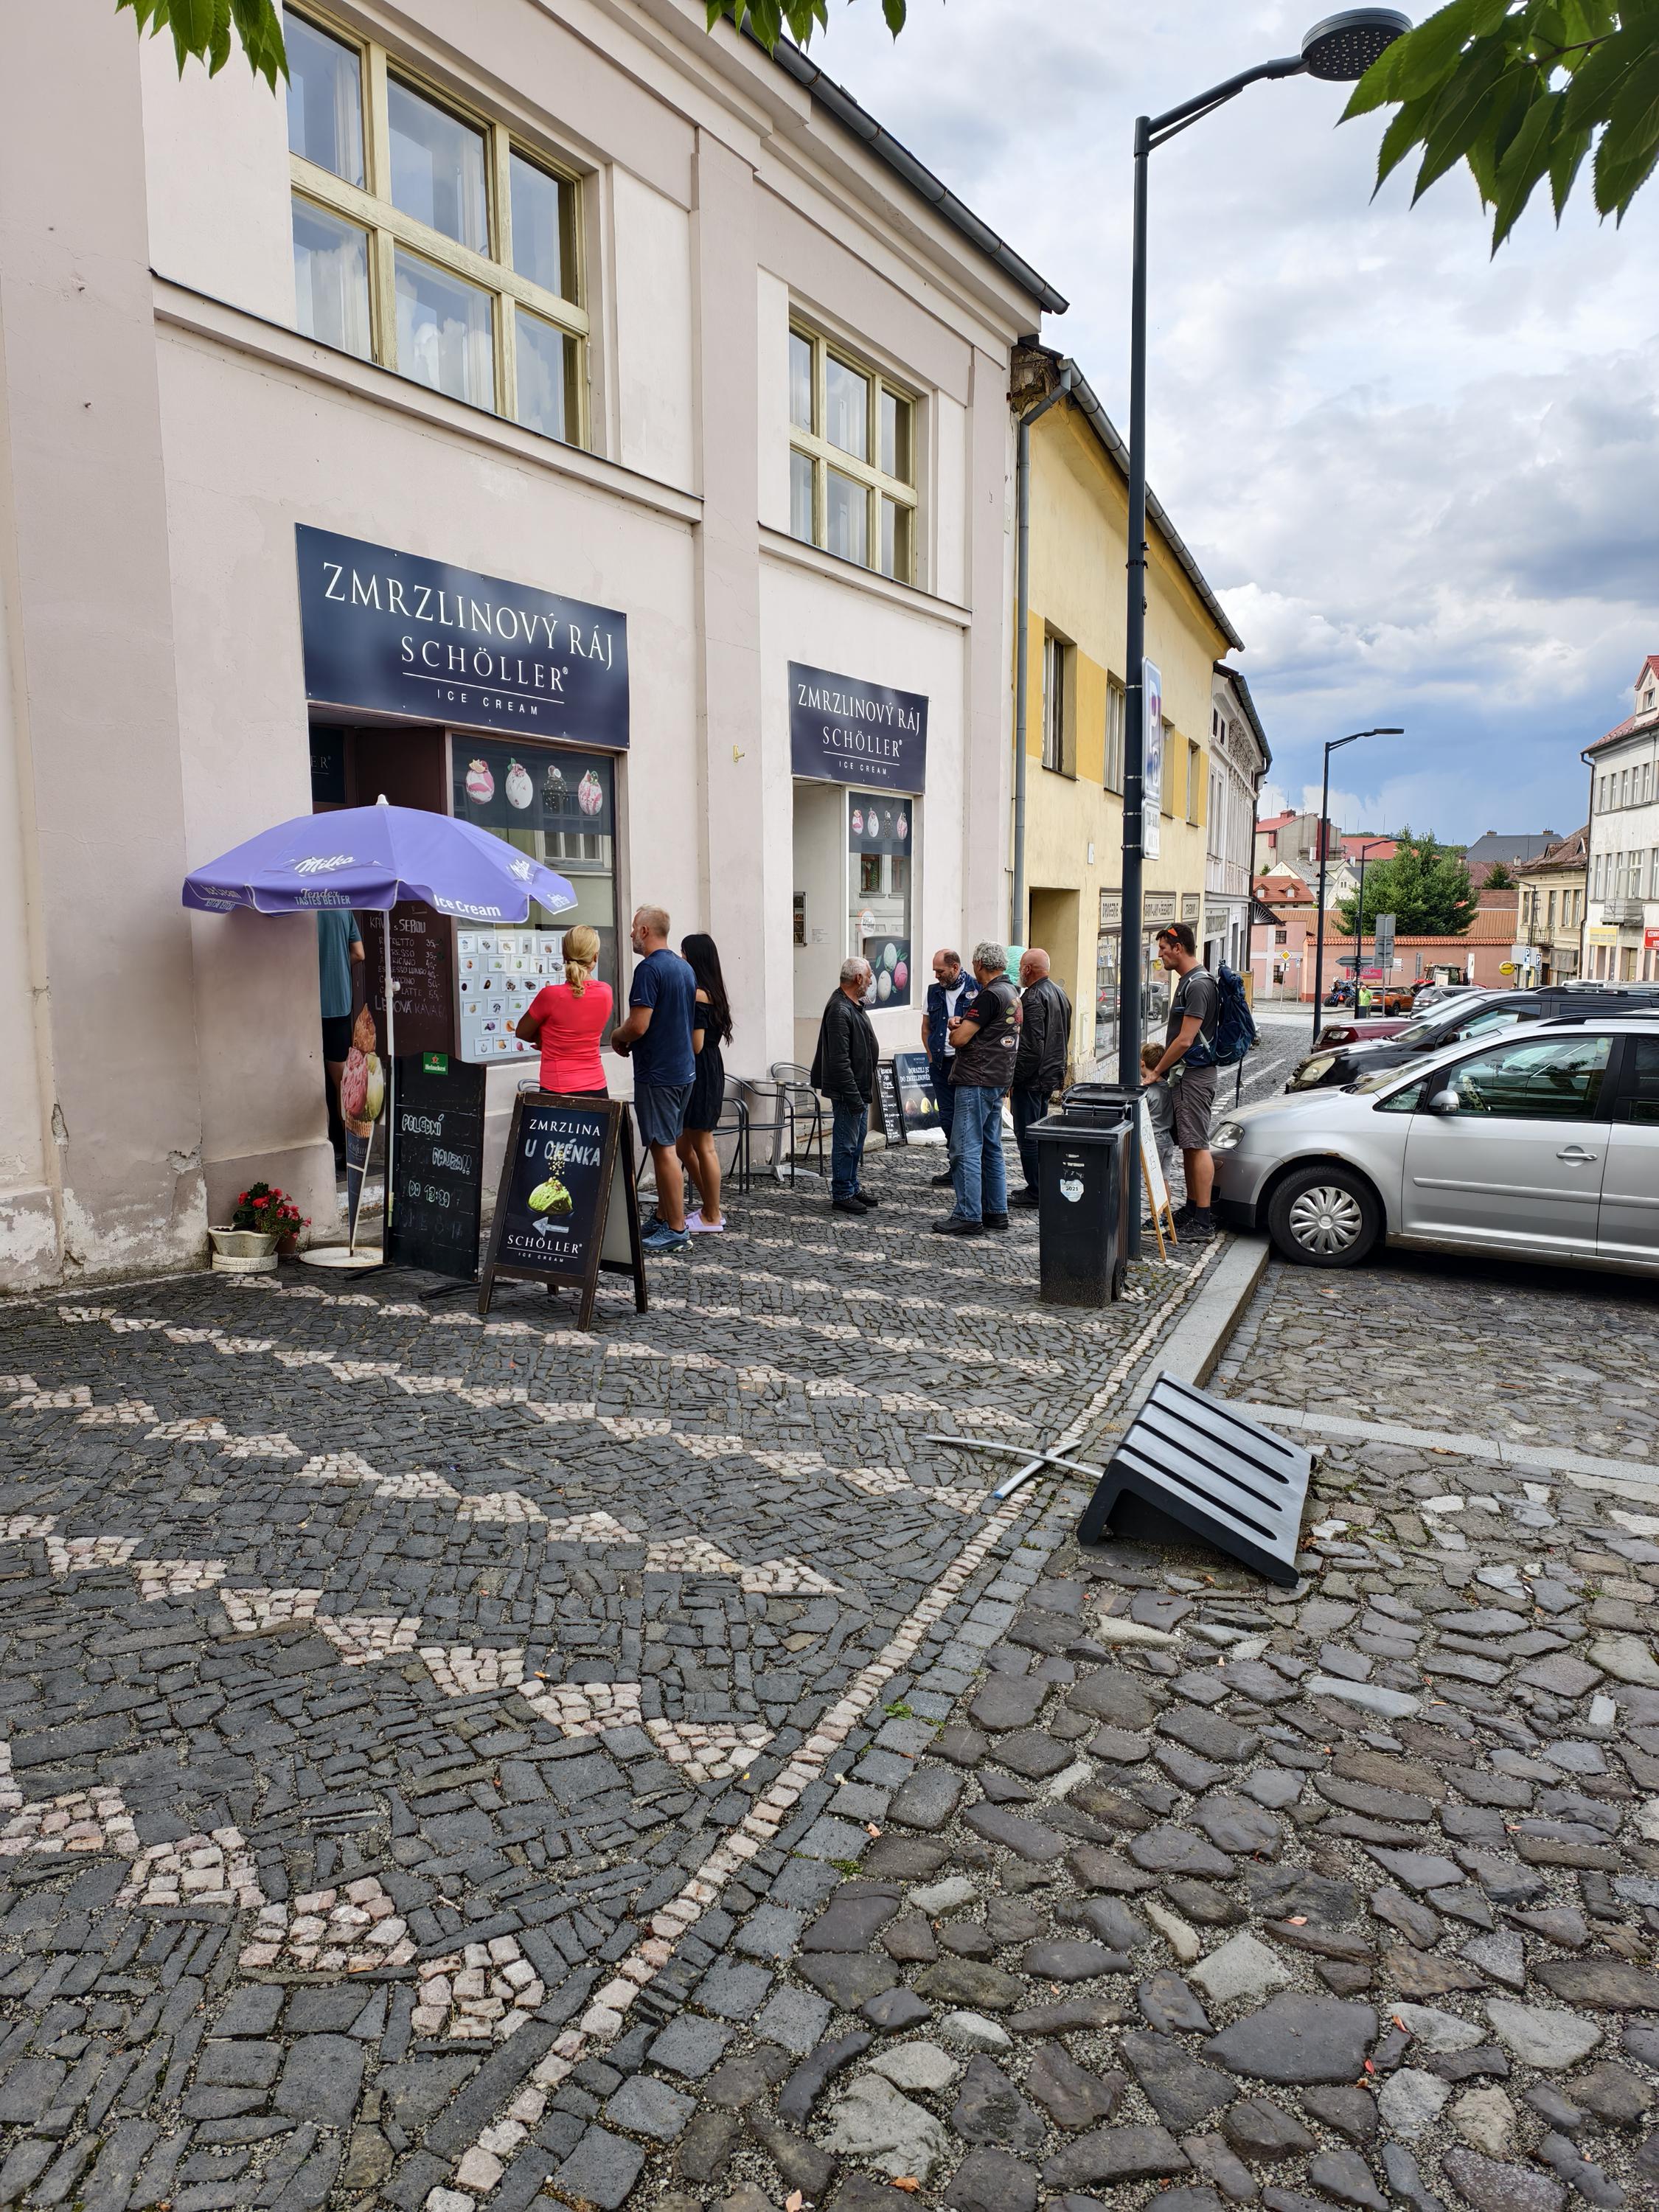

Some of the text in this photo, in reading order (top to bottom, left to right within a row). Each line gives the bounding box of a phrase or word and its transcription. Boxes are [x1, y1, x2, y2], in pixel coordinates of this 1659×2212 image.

[323, 562, 613, 670] ZMRZLINOVÝ RÁJ
[437, 689, 538, 715] ICE CREAM
[798, 684, 920, 737] ZMRZLINOVÝ RÁJ
[839, 760, 887, 775] ICE CREAM
[295, 855, 355, 873] Milka
[294, 895, 351, 905] TASTES BETTER
[301, 888, 340, 897] Tender
[434, 894, 501, 917] Ice Cream
[399, 919, 426, 933] SEBOU
[402, 1113, 445, 1136] POLEDNÍ
[529, 1119, 600, 1136] ZMRZLINA
[524, 1138, 600, 1166] U OKÉNKA
[408, 1180, 450, 1208] DO 13:30
[538, 1254, 564, 1263] CREAM
